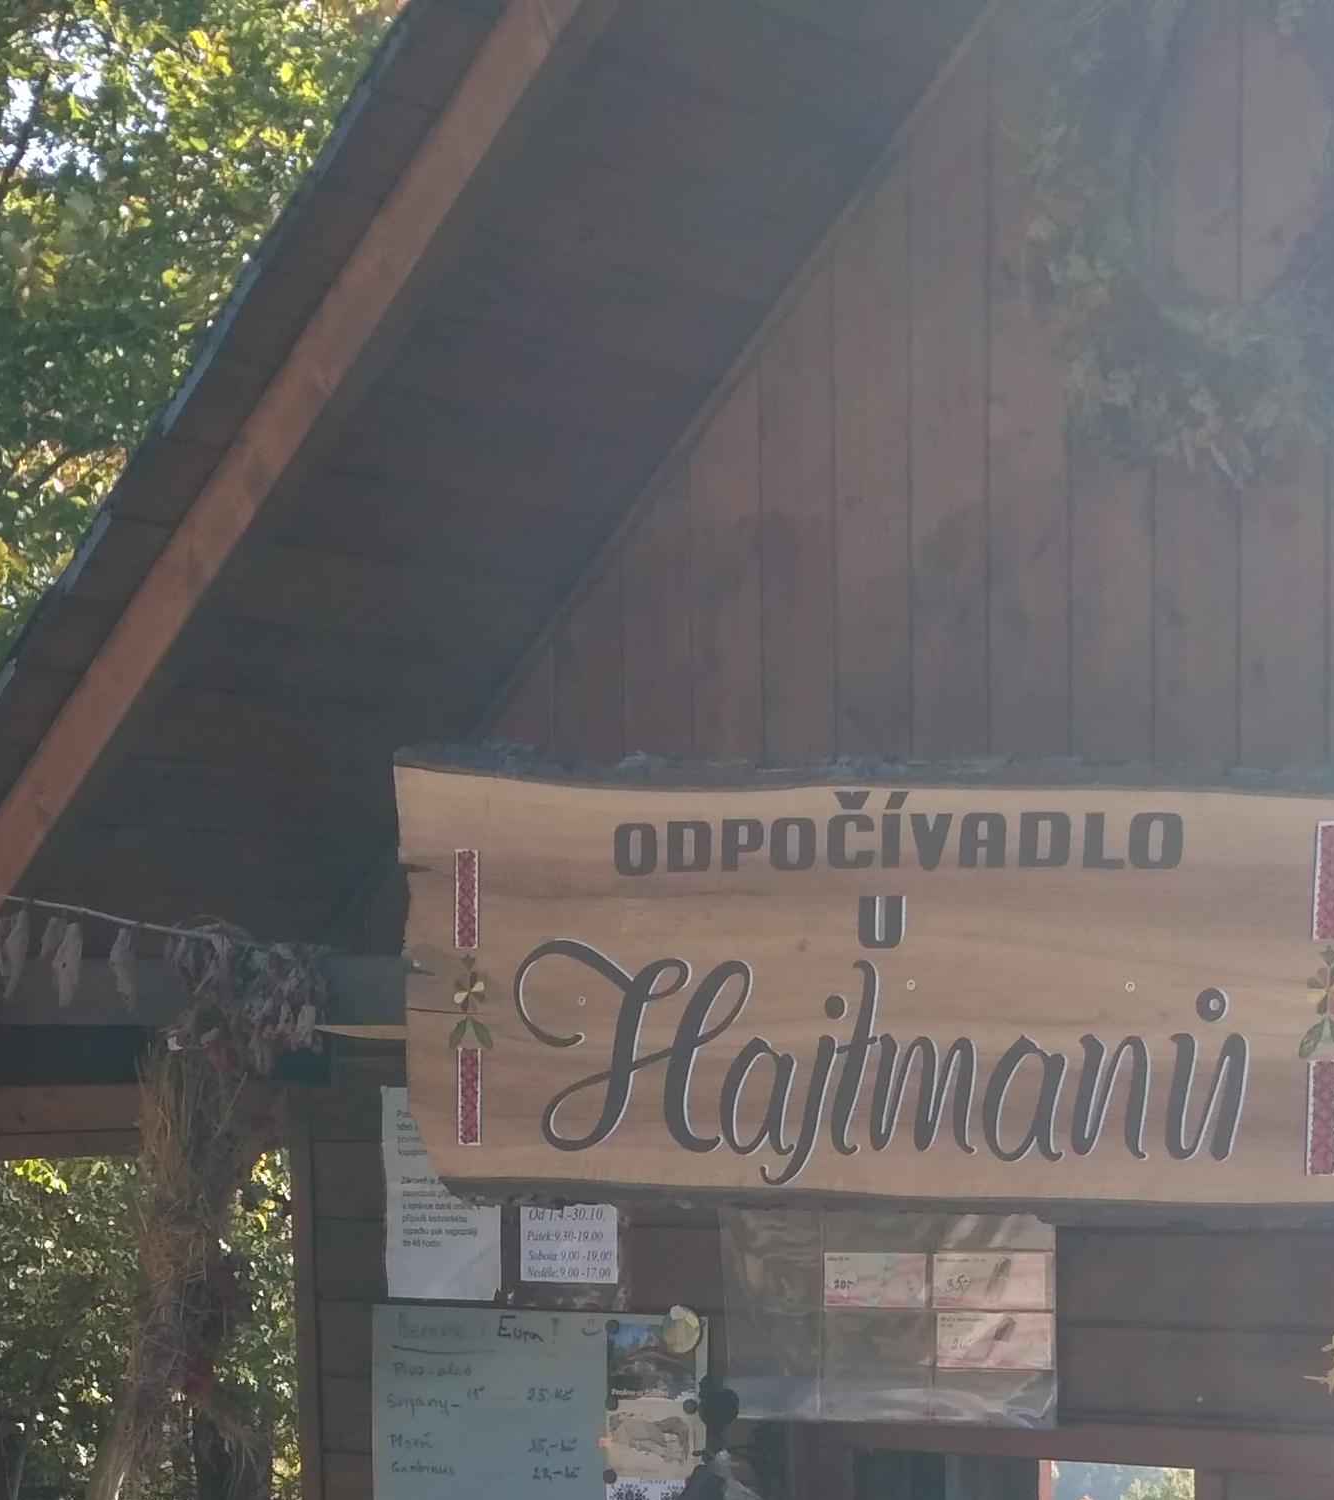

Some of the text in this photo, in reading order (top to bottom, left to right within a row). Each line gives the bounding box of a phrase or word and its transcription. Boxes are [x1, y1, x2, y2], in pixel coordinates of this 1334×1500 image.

[613, 791, 1183, 876] ODPOČÍVADLO
[858, 895, 908, 949] U
[529, 1208, 545, 1221] Od
